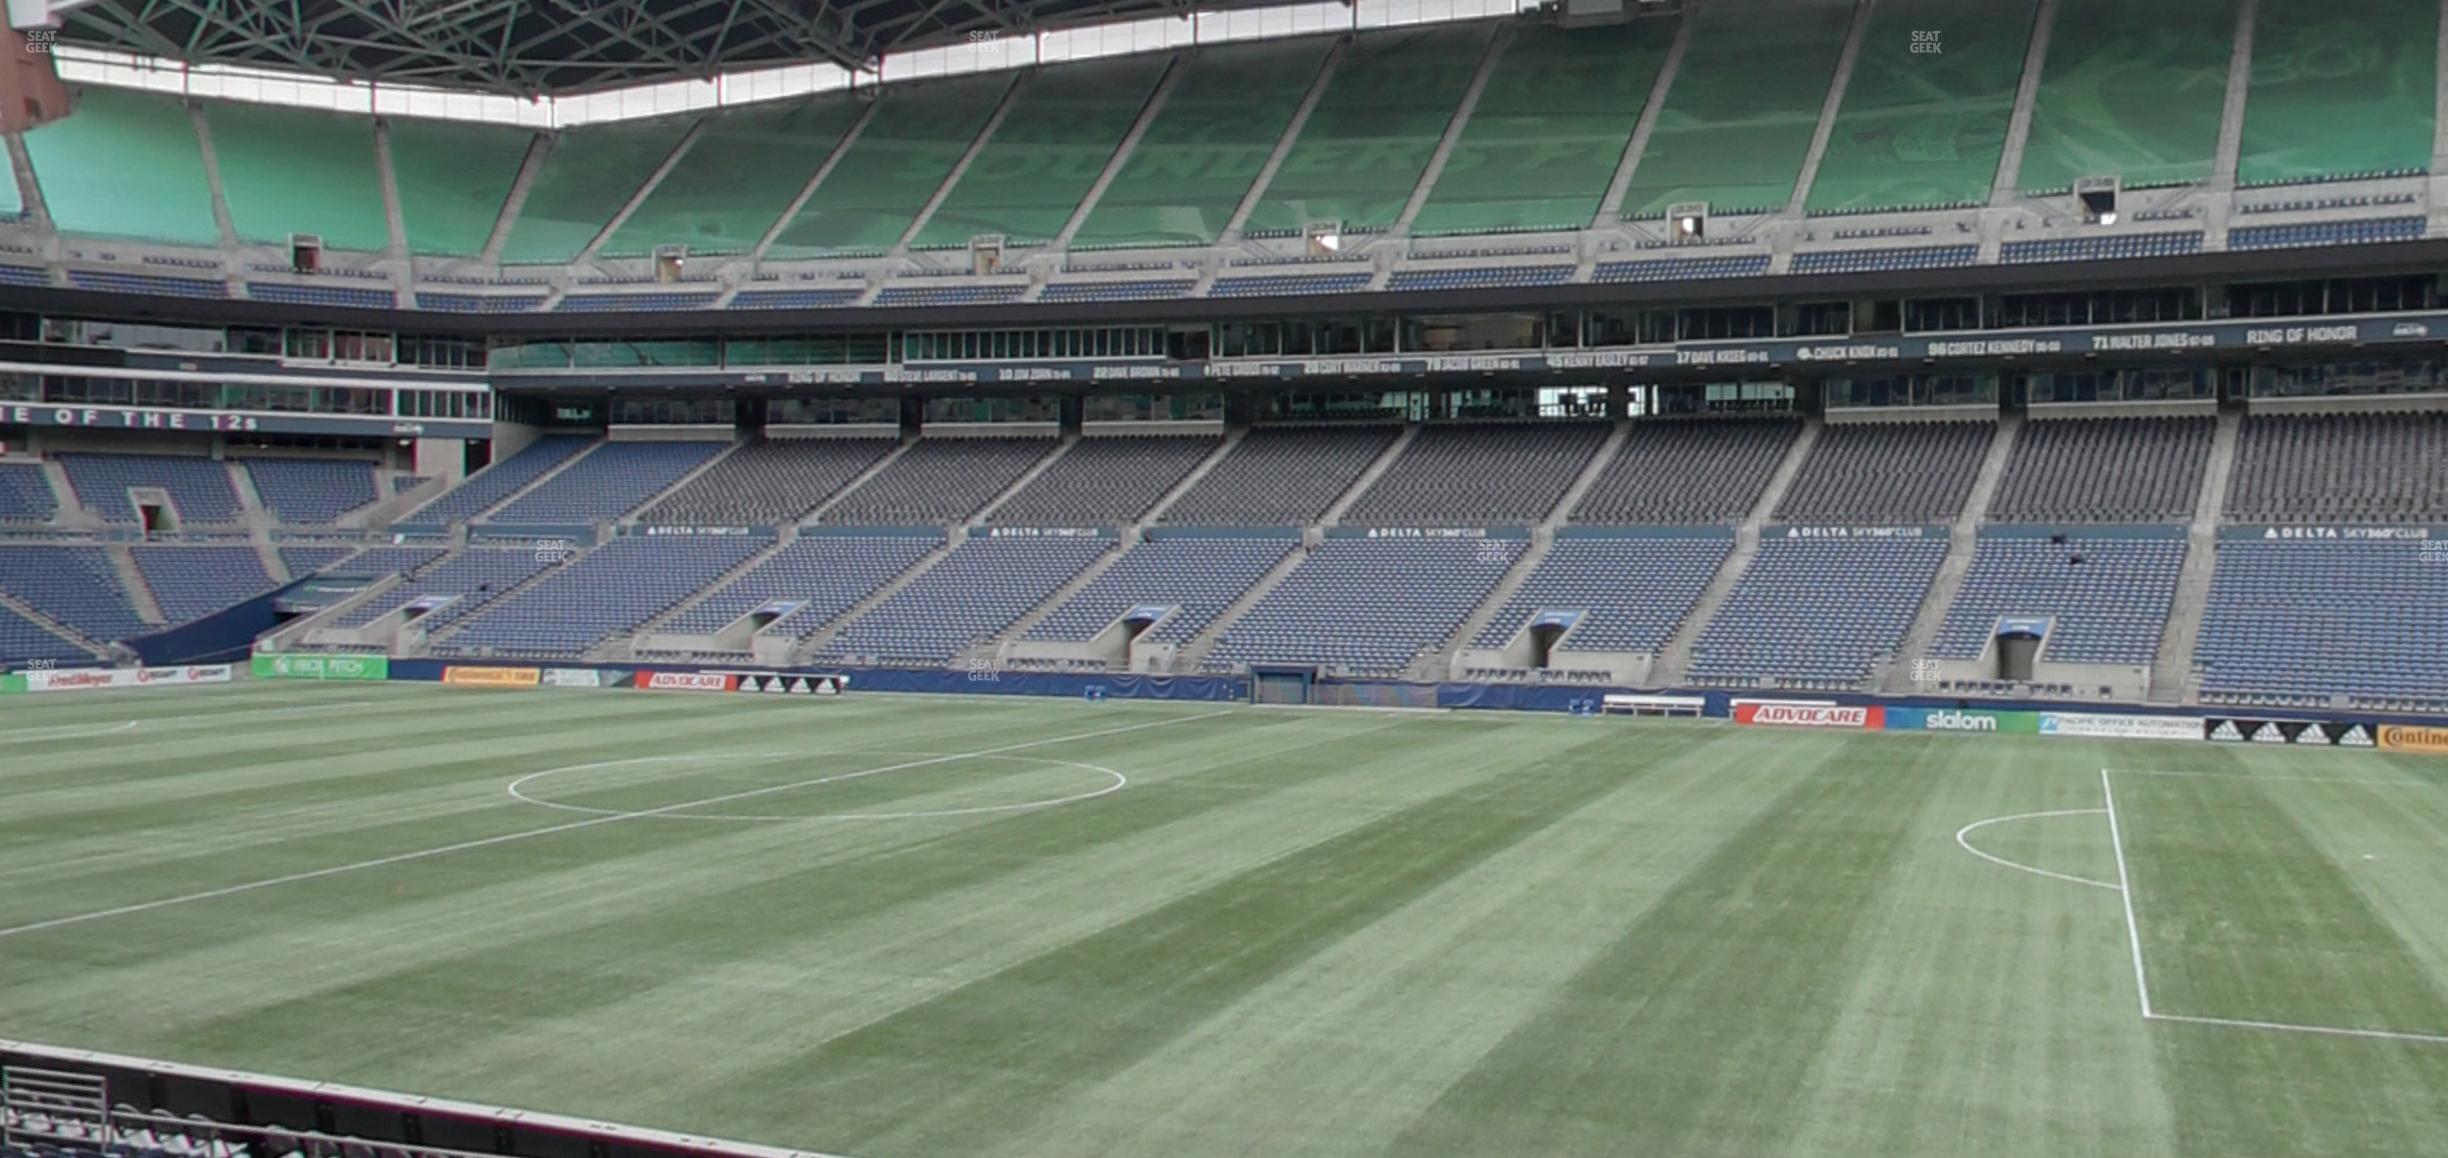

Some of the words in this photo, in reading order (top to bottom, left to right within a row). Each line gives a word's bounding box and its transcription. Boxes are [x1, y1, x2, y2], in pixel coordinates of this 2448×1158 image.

[2092, 336, 2109, 350] 71
[2153, 333, 2188, 348] JONES
[2246, 329, 2284, 345] RING
[2286, 327, 2304, 343] OF
[2307, 325, 2358, 342] HONOR
[1813, 346, 1848, 360] CHUCK
[1948, 341, 1986, 356] CORTEZ
[1987, 339, 2036, 355] KENNEDY
[1676, 351, 1690, 365] 17
[54, 408, 97, 425] OF
[121, 411, 185, 429] THE
[209, 414, 257, 430] 12s
[658, 526, 693, 535] DELTA
[1001, 527, 1039, 537] DELTA
[1380, 528, 1421, 538] DELTA
[1801, 526, 1848, 537] DELTA
[2281, 527, 2337, 538] DELTA
[653, 673, 725, 689] ADVOCARE
[1755, 706, 1865, 724] ADVOCARE
[1926, 709, 1997, 731] slalom
